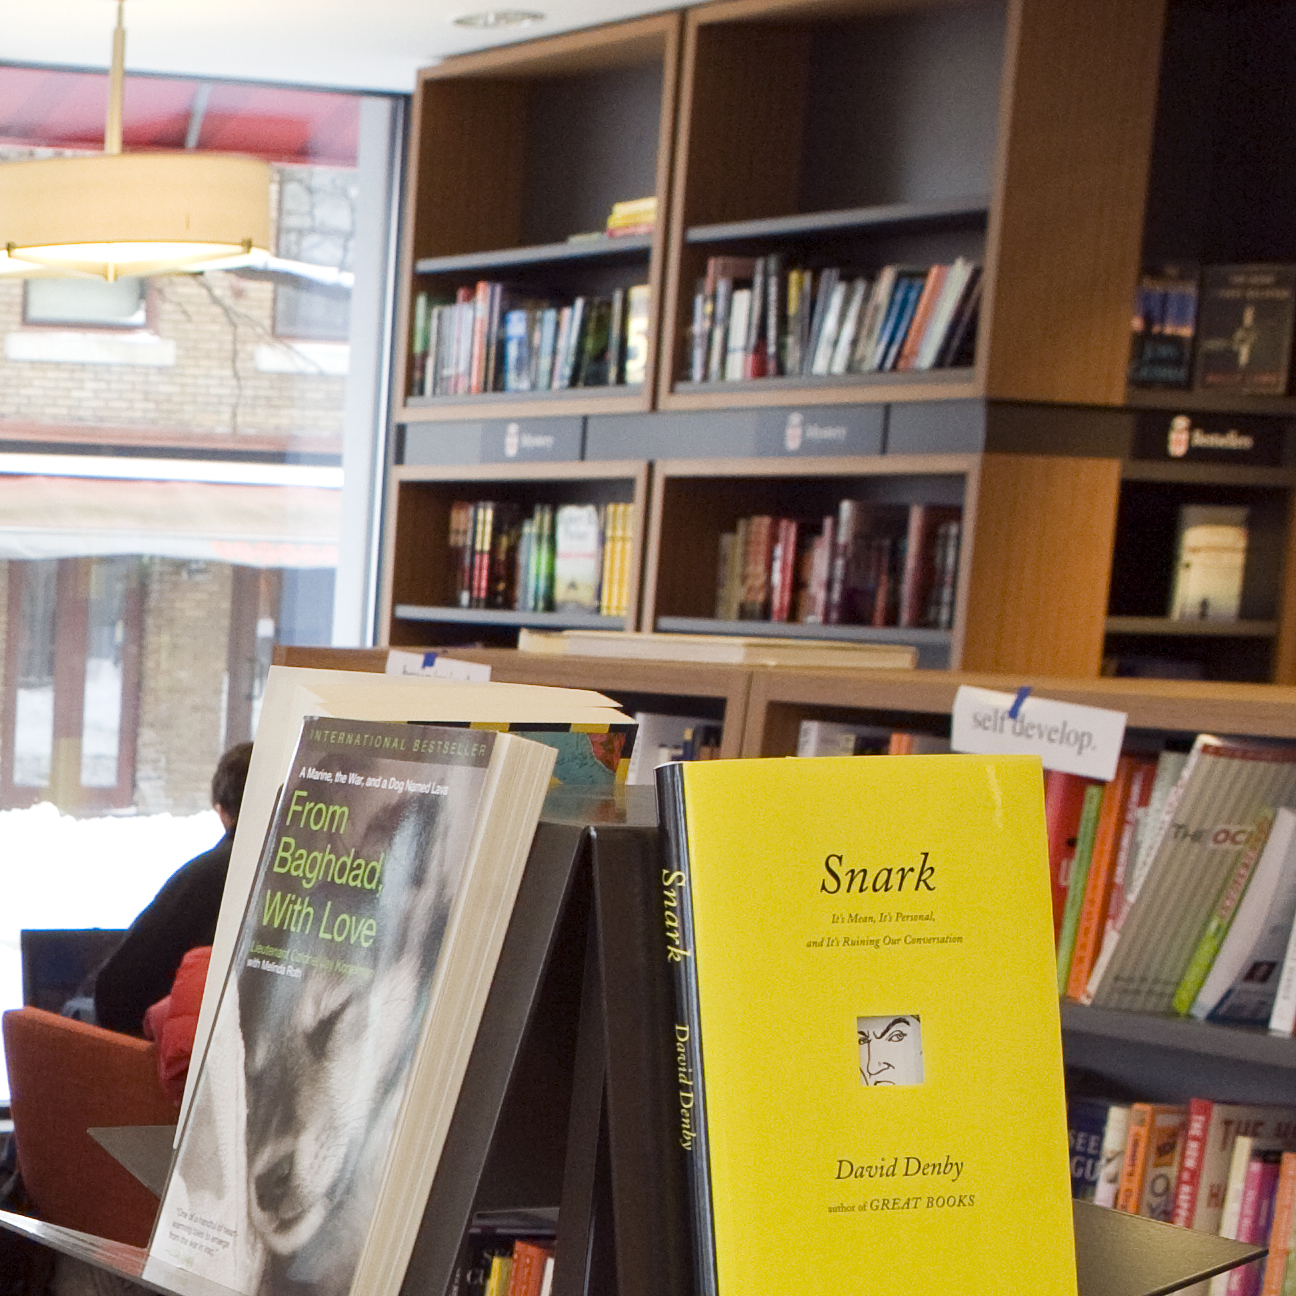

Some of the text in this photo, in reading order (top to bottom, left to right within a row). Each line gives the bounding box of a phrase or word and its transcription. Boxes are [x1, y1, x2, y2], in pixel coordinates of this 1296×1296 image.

[309, 729, 487, 757] INTERNATIONAL BESTSELLER
[972, 711, 1097, 755] self develop.
[307, 768, 333, 784] Marine,
[335, 771, 347, 784] the
[348, 772, 365, 788] War,
[365, 775, 381, 789] and
[388, 777, 405, 793] Dog
[405, 779, 430, 795] Named
[430, 782, 449, 796] Lava
[285, 790, 349, 835] From
[273, 836, 385, 896] Baghdad,
[821, 853, 937, 894] Snark
[262, 889, 377, 947] With Love
[661, 868, 692, 962] Snark
[831, 911, 936, 924] It's Mean, It's Personal,
[806, 934, 963, 949] and It's Ruining Our Conversation
[261, 960, 286, 976] Melinda
[286, 965, 301, 978] Roth
[674, 1024, 697, 1151] David Denby
[836, 1156, 964, 1182] David Denby
[828, 1194, 975, 1213] author of GREAT BOOKS
